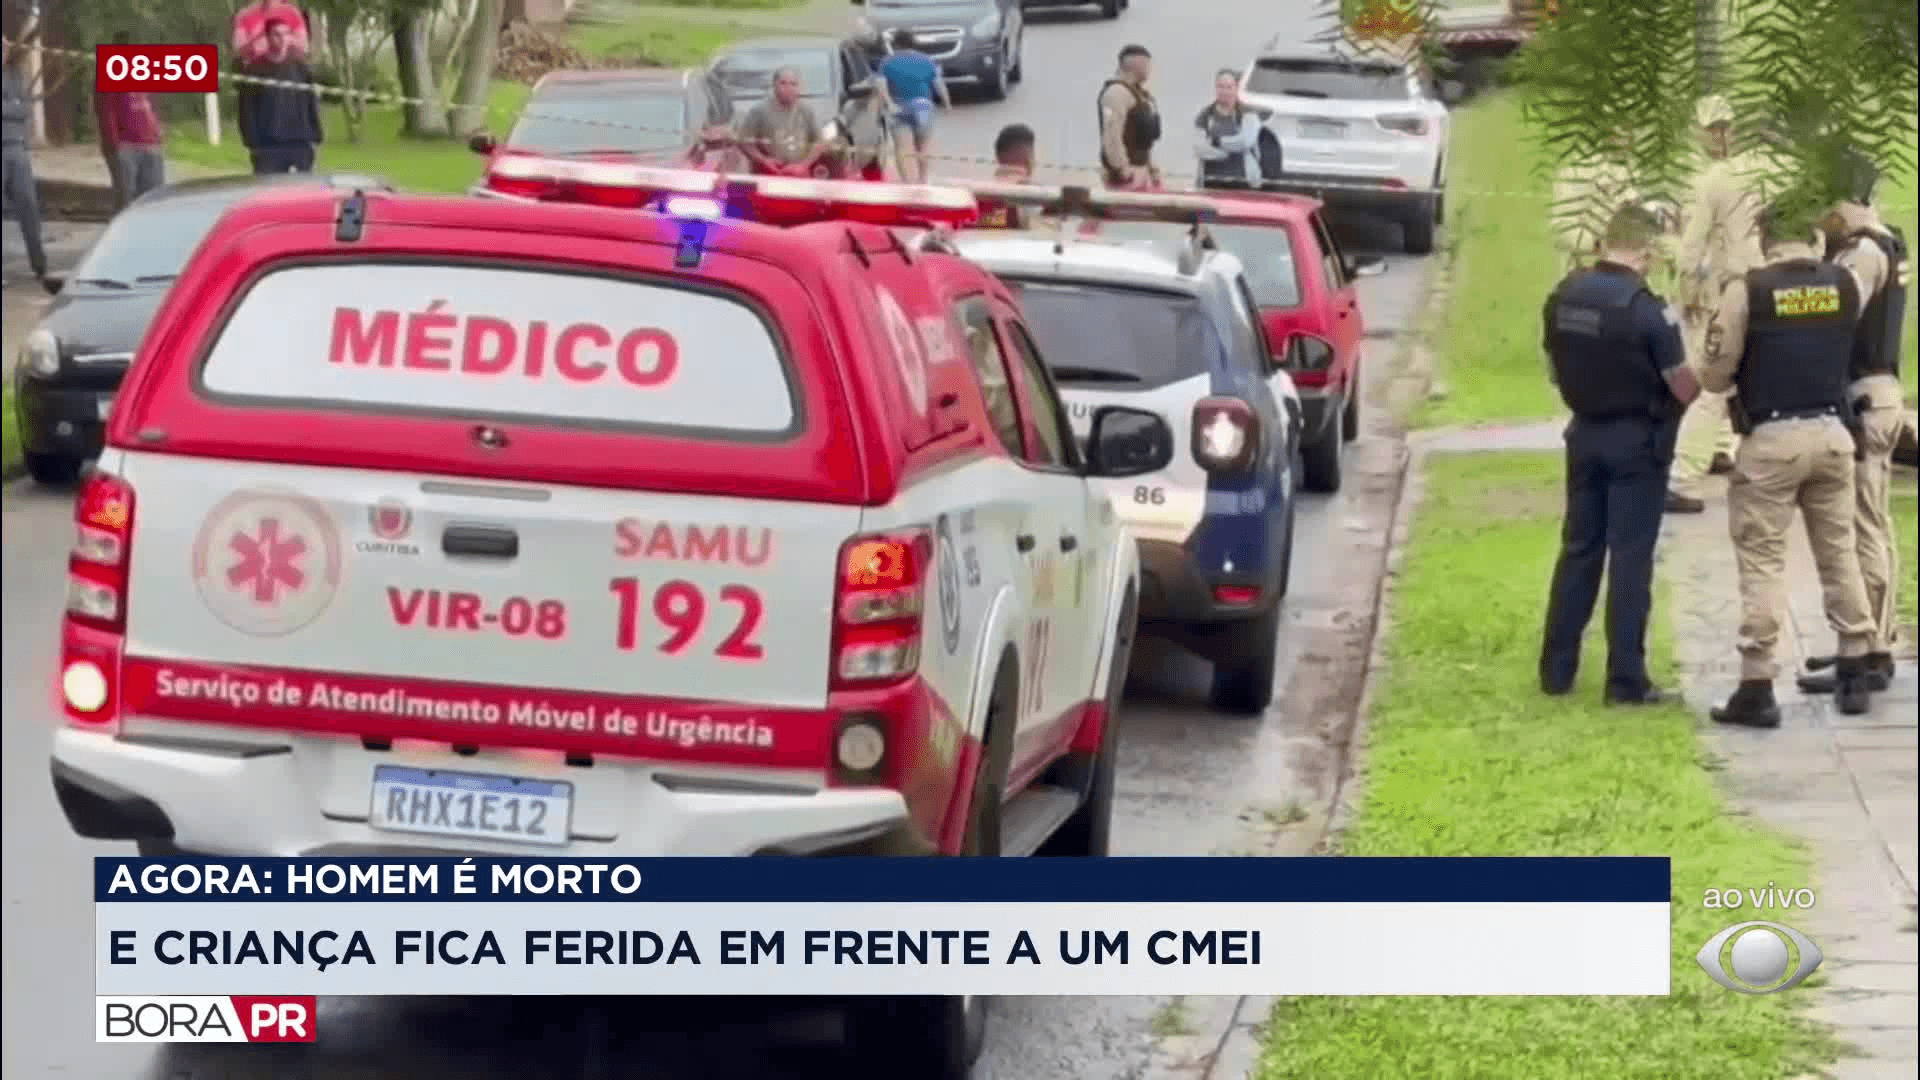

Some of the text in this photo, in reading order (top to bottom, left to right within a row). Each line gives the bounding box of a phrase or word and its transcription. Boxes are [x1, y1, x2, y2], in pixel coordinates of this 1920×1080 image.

[329, 300, 680, 387] MÉDICO
[1133, 485, 1166, 505] 86
[614, 516, 773, 567] SAMU
[386, 585, 567, 640] VIR-08
[608, 576, 766, 660] 192
[156, 668, 775, 748] Serviço de Atendimento Móvel de Urgência
[385, 786, 550, 836] RHX1E12
